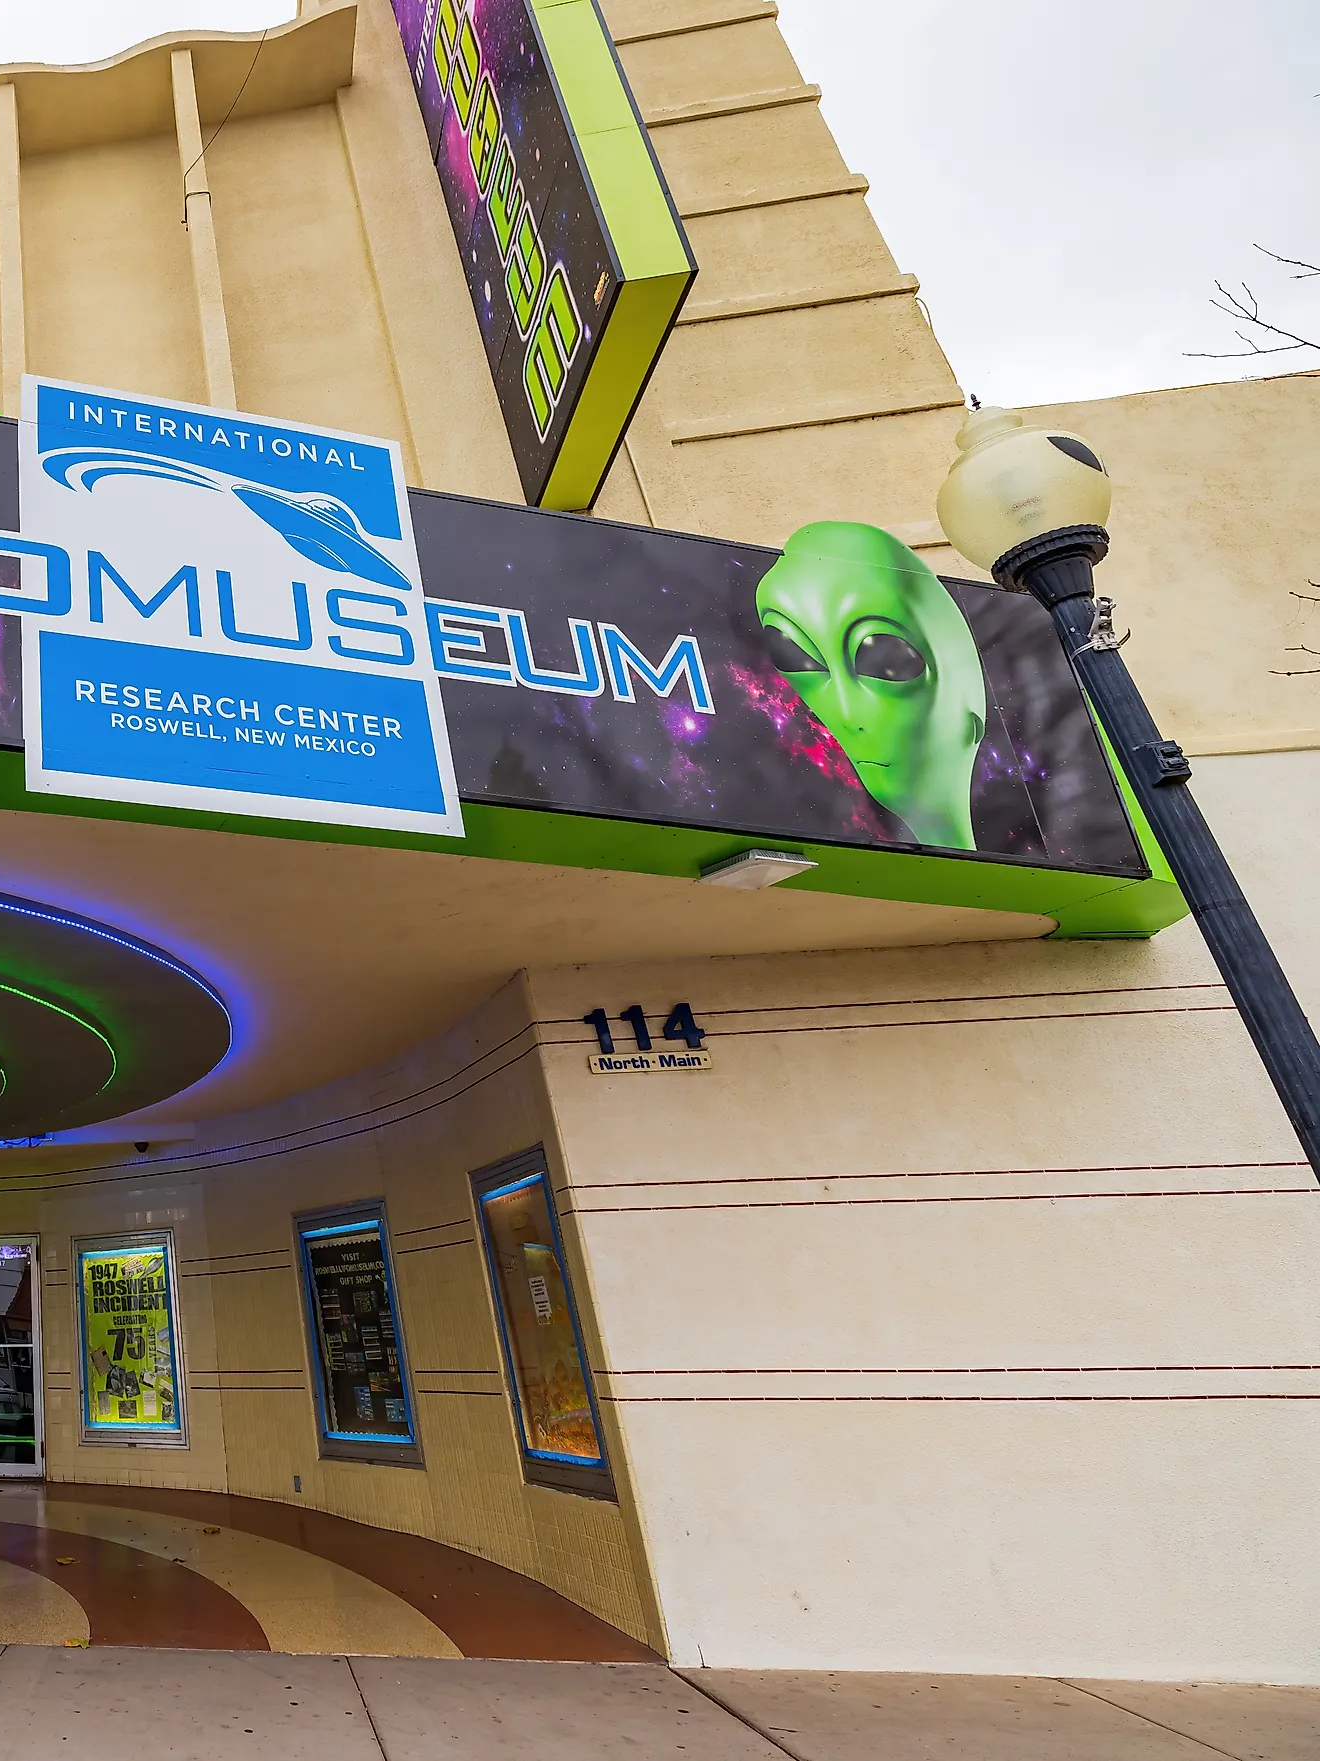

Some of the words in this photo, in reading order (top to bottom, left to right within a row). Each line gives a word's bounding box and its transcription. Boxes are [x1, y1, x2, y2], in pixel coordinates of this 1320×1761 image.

[68, 401, 366, 471] INTERNATIONAL
[75, 679, 260, 722] RESEARCH
[275, 703, 403, 740] CENTER
[110, 712, 228, 743] ROSWELL,
[235, 727, 286, 747] NEW
[294, 734, 377, 758] MEXICO
[583, 1002, 705, 1054] 114
[598, 1056, 650, 1070] North
[658, 1054, 702, 1068] Main
[341, 1252, 360, 1262] VISIT
[88, 1263, 118, 1280] 1947
[340, 1277, 354, 1286] GIFT
[355, 1275, 373, 1284] SHOP
[92, 1275, 167, 1297] ROSWELL
[93, 1293, 167, 1314] INCIDENT
[107, 1328, 146, 1361] 75
